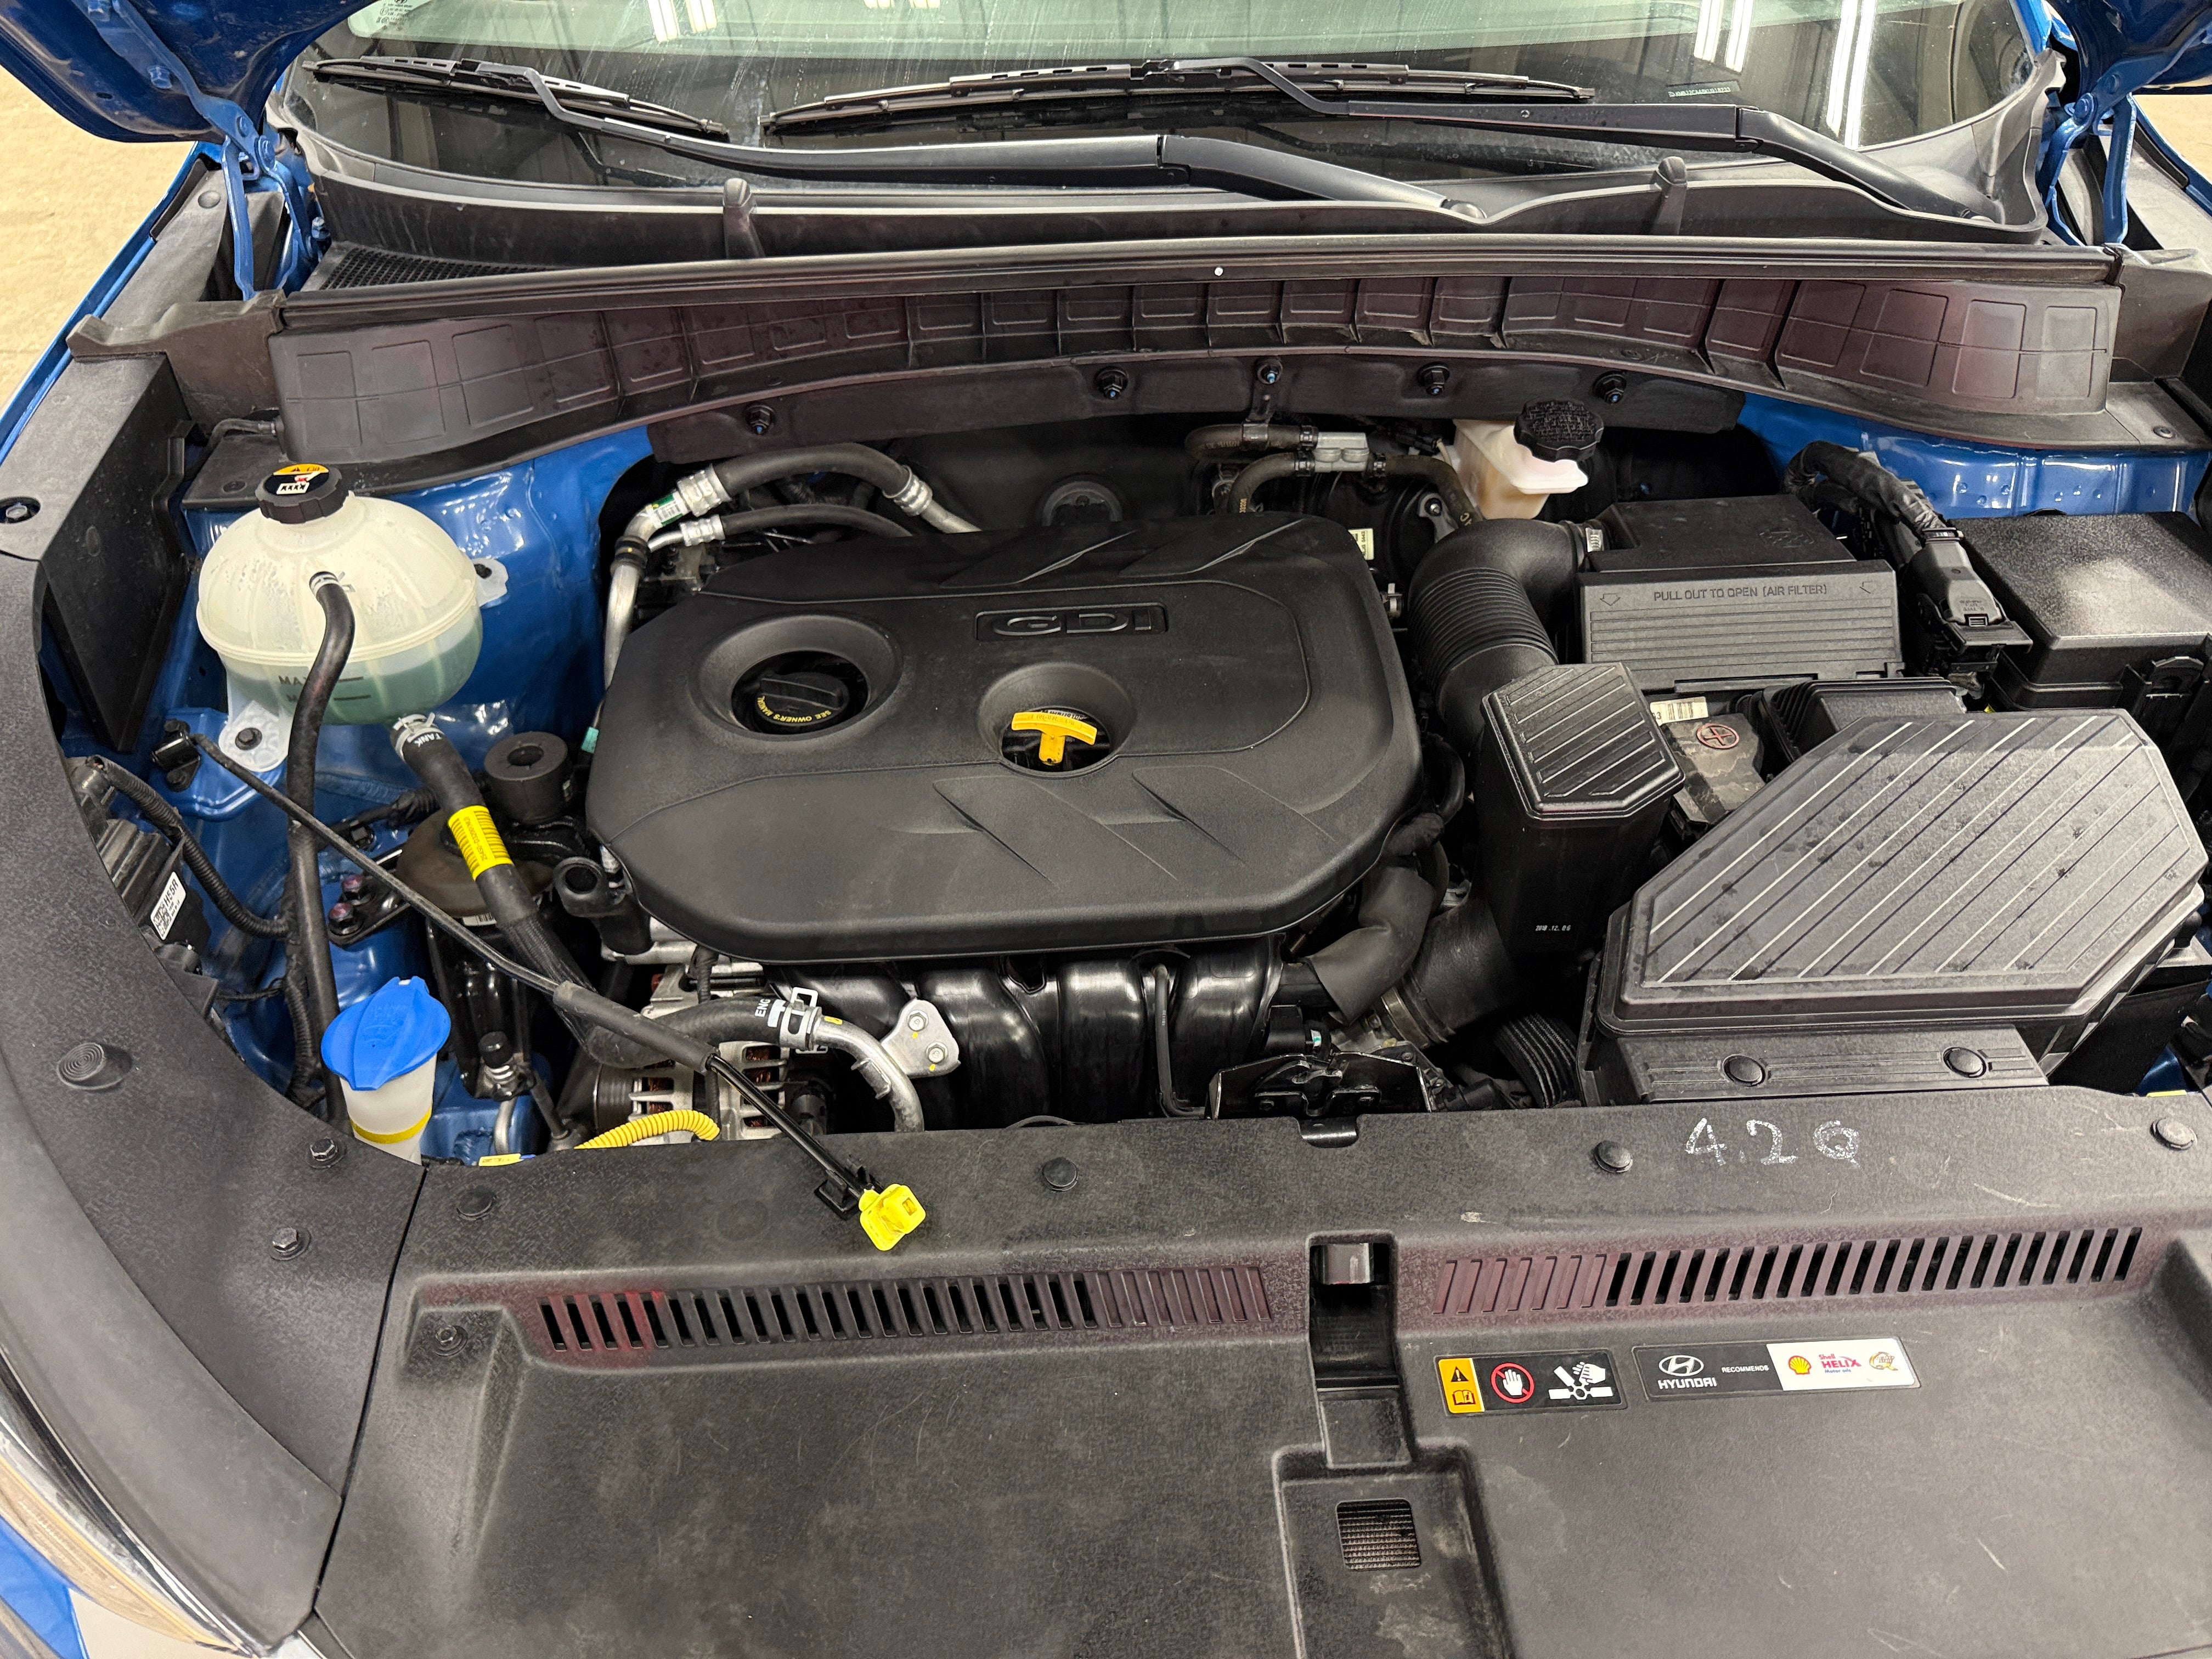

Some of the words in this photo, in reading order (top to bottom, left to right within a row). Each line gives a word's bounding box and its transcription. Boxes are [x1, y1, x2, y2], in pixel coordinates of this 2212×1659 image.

[1654, 591, 1683, 601] PULL
[1685, 589, 1707, 599] OUT
[1709, 588, 1725, 598] TO
[1728, 586, 1758, 597] OPEN
[1787, 583, 1827, 596] FILTER)
[993, 608, 1152, 636] GDI
[773, 713, 812, 723] OWNER'S
[814, 710, 832, 720] SEE
[414, 733, 442, 747] TANK
[755, 999, 771, 1017] ENG
[1821, 1357, 1862, 1368] HELIX
[1722, 1365, 1769, 1373] RECOMMENDS
[1657, 1377, 1717, 1389] HYUNDAI
